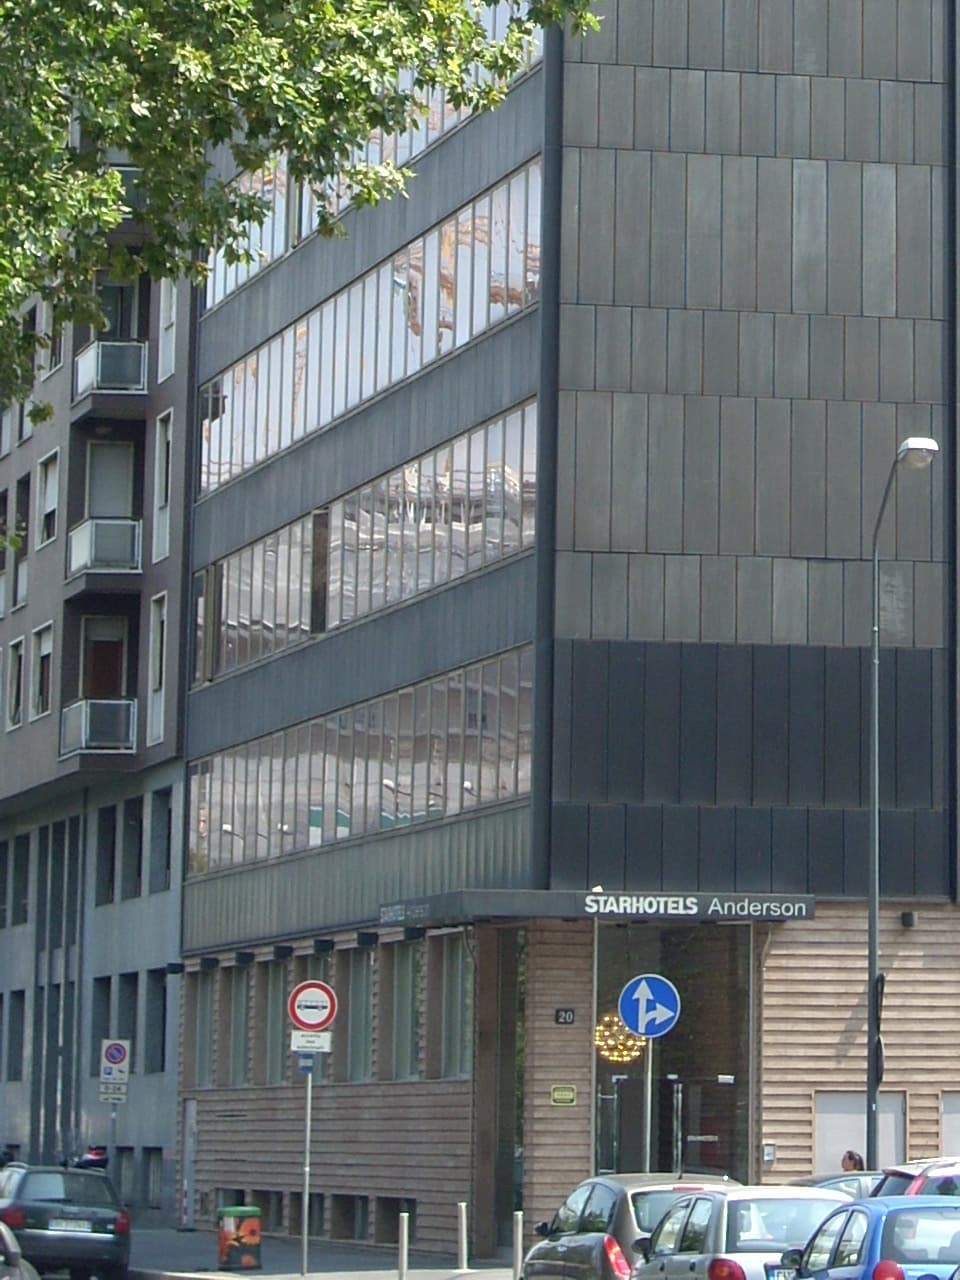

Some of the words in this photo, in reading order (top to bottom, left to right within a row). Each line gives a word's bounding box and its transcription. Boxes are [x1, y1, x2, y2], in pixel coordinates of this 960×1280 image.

[585, 895, 698, 915] STARHOTELS
[707, 897, 807, 917] Anderson
[557, 1010, 574, 1023] 20
